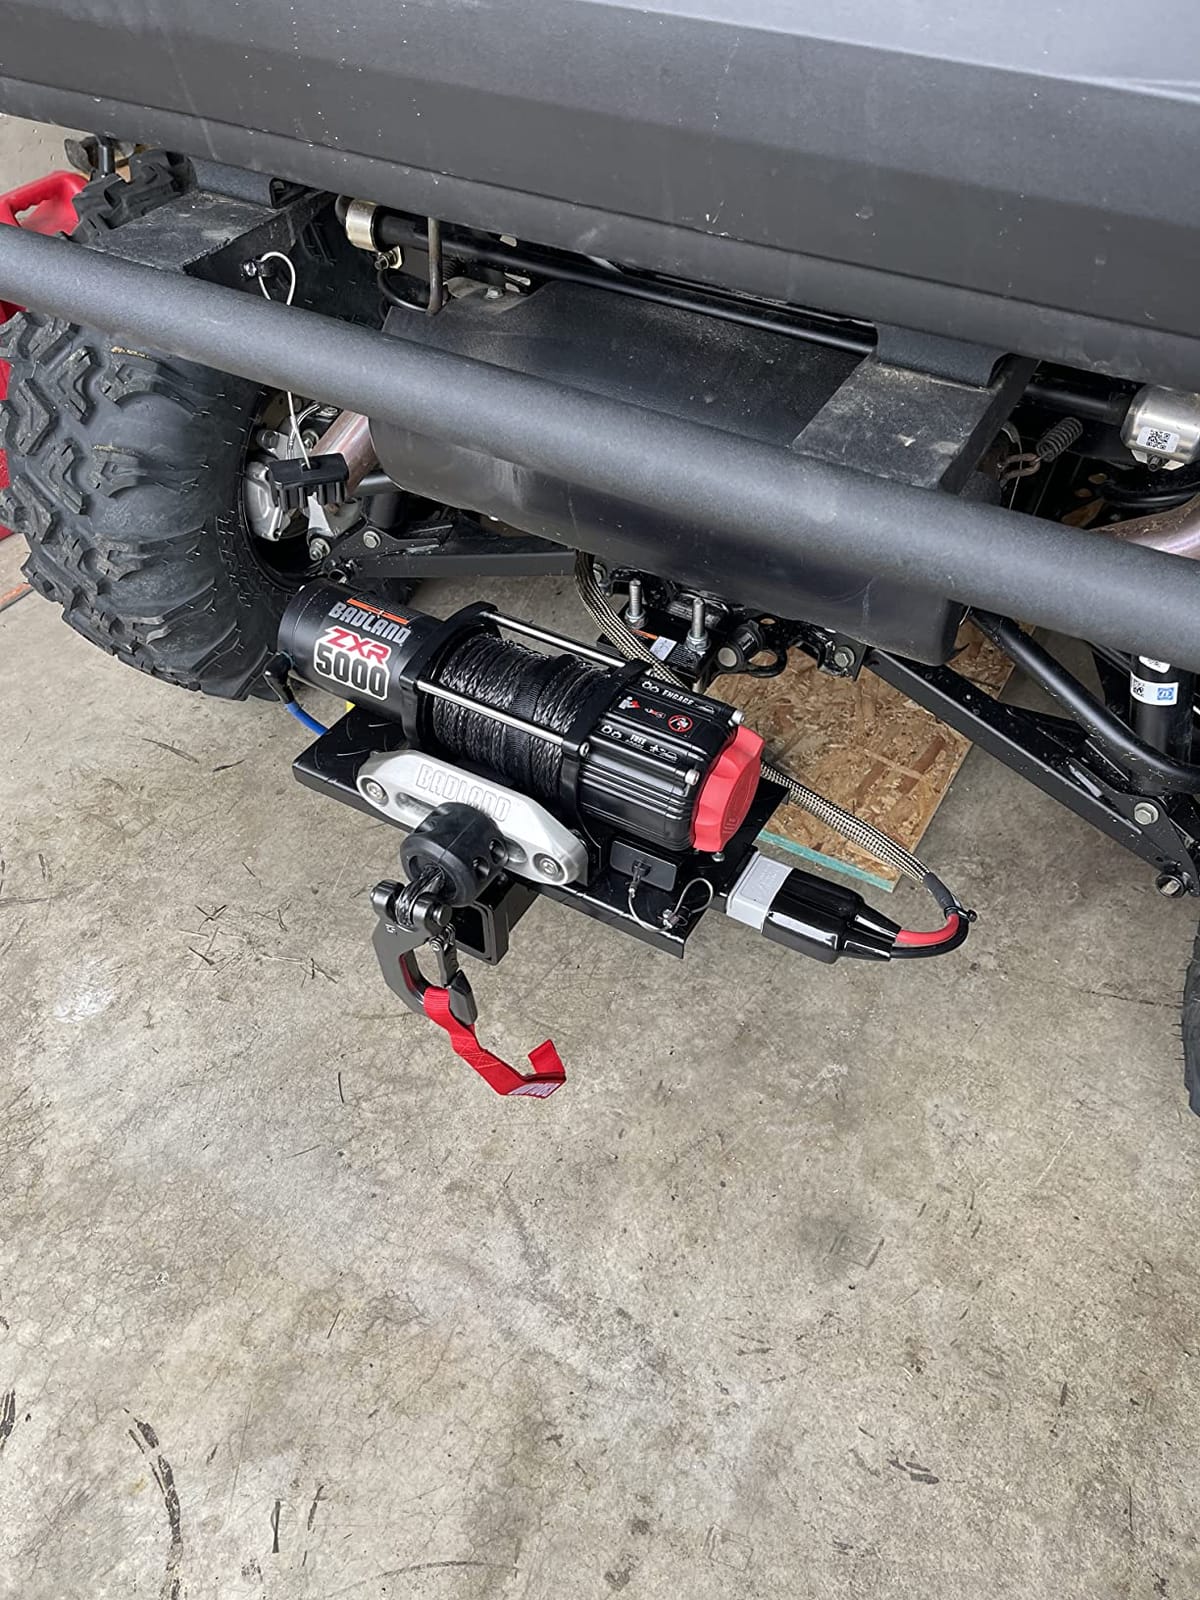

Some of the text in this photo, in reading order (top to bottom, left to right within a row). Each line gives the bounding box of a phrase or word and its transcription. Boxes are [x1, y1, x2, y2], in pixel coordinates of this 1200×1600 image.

[325, 626, 391, 666] ZXR
[328, 601, 412, 645] BADLAND
[315, 644, 389, 699] 5000
[415, 763, 512, 822] BADLAND
